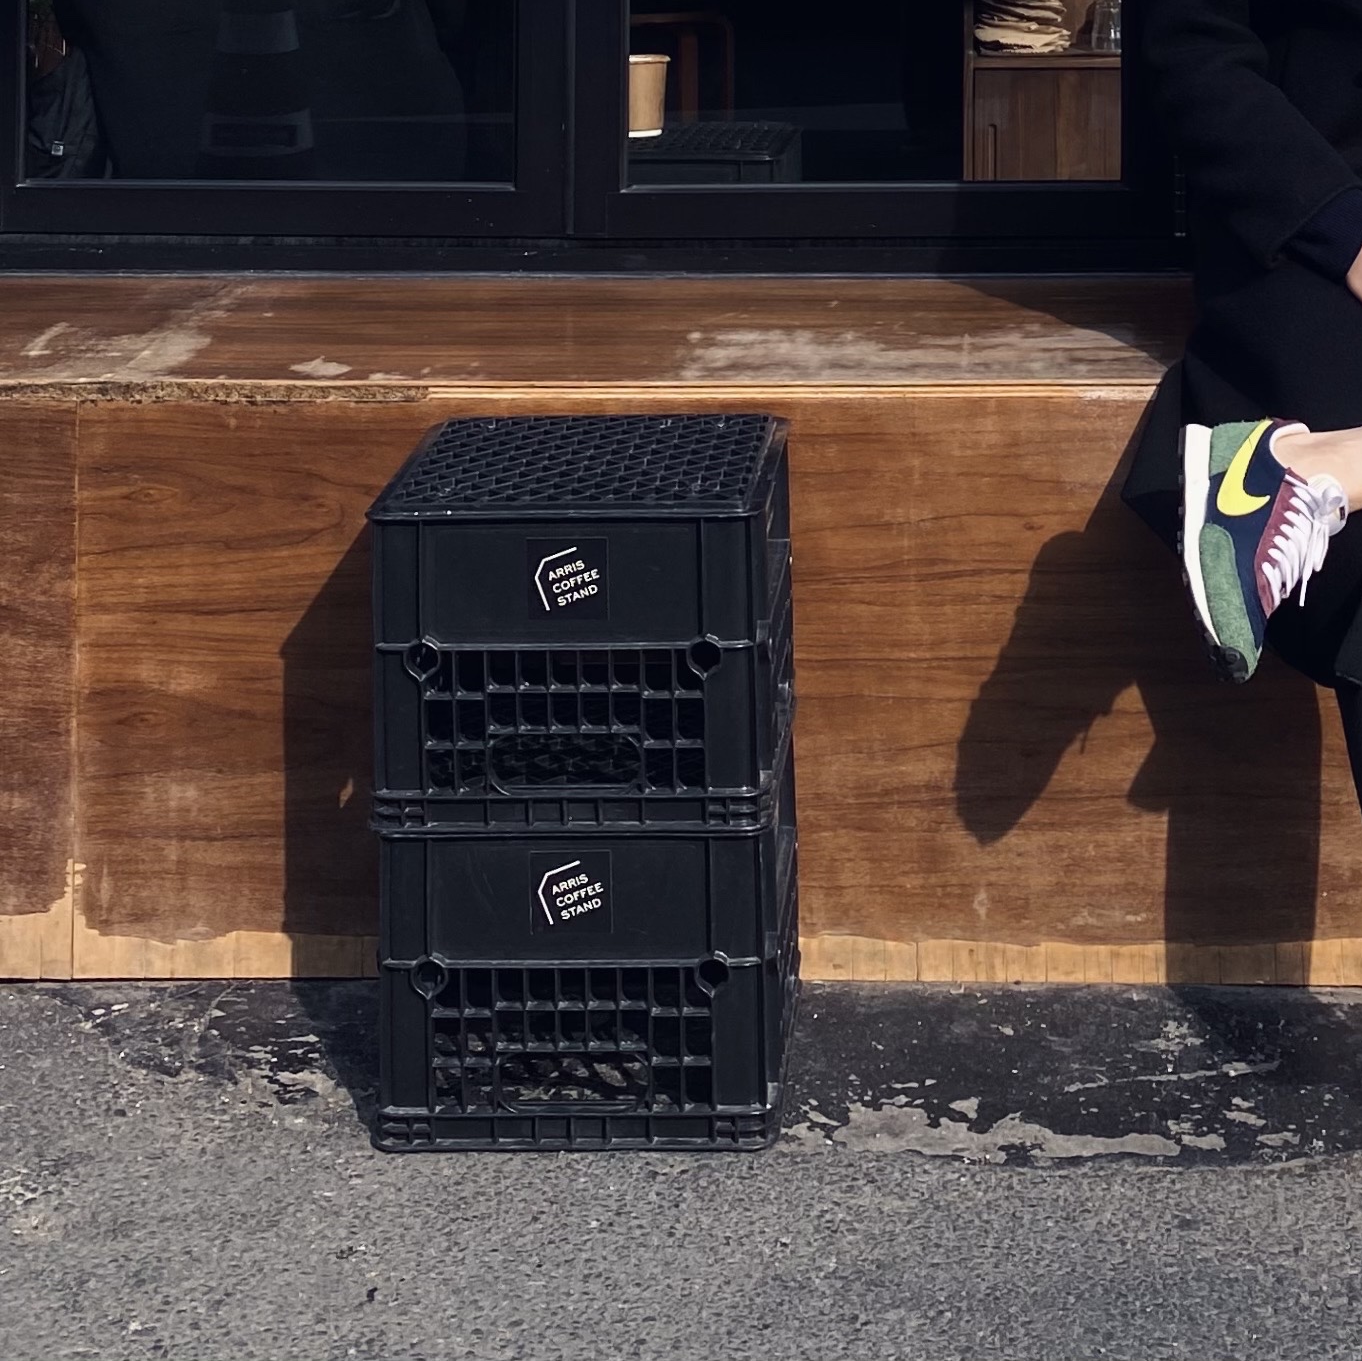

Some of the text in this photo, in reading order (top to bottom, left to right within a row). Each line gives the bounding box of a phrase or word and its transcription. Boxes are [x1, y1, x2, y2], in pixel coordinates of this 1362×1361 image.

[549, 560, 585, 581] ARRIS
[553, 569, 600, 593] COFFEE
[557, 585, 598, 606] STAND
[552, 873, 588, 895] ARRIS
[556, 882, 603, 907] COFFEE
[561, 898, 601, 919] STAND
